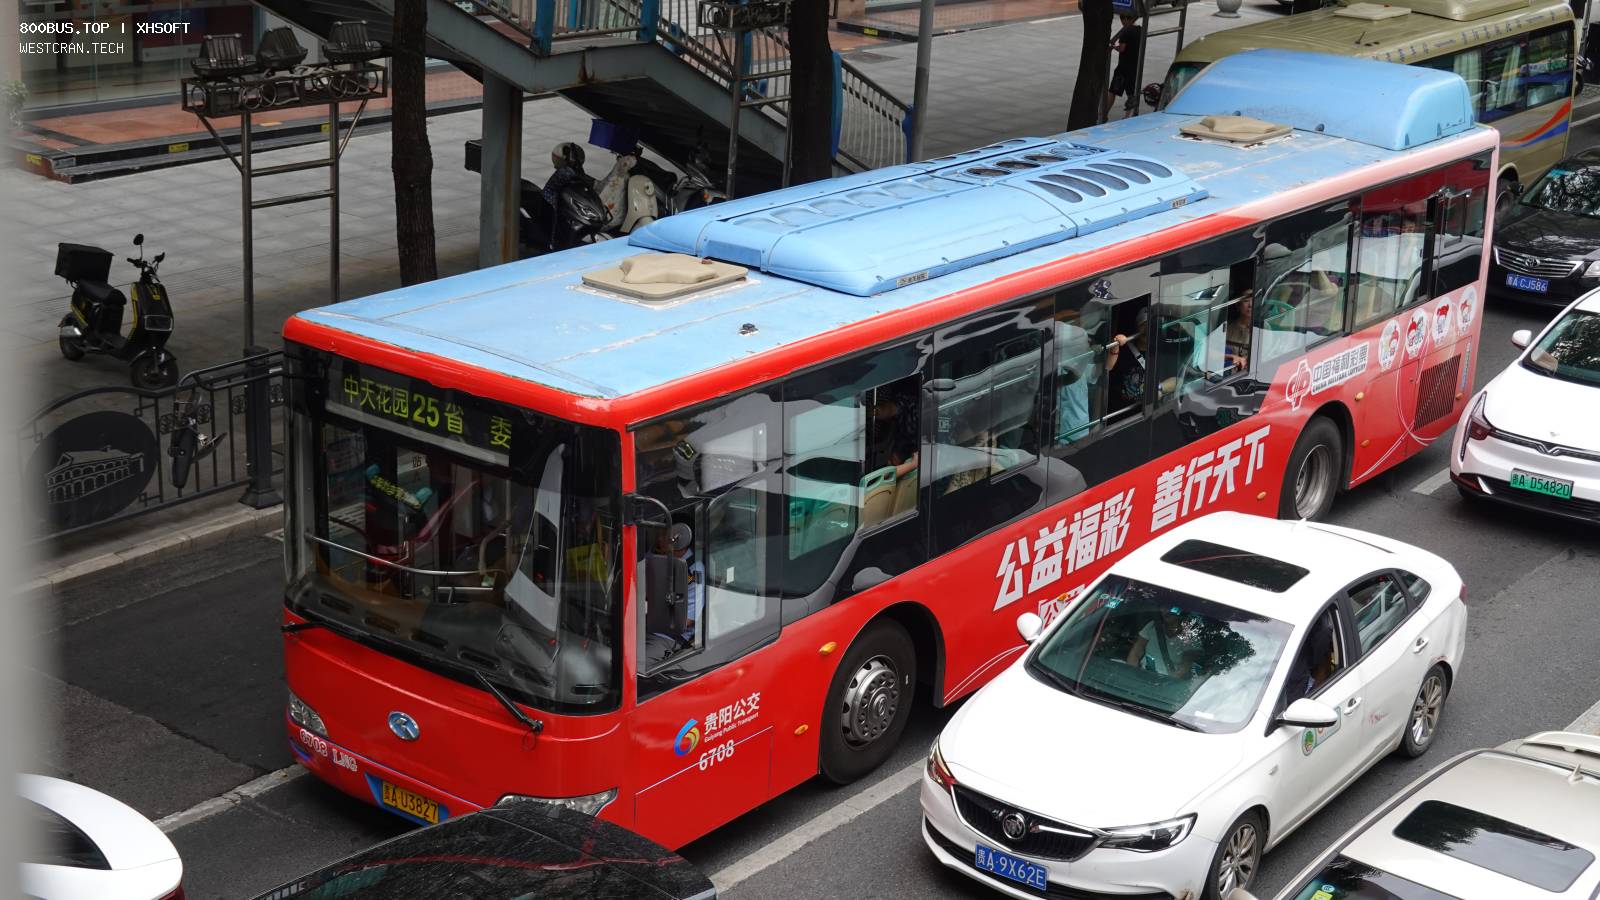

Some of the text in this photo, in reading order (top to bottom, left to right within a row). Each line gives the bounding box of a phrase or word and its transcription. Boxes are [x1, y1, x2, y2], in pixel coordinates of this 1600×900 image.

[343, 375, 409, 418] 中天花园
[412, 393, 440, 428] 25
[992, 424, 1271, 612] 公益福彩 善行天下
[704, 692, 760, 735] 贵阳公交
[723, 723, 737, 734] Public
[737, 712, 759, 727] Transport
[299, 728, 358, 772] 6708 LNG
[699, 739, 735, 771] 6708
